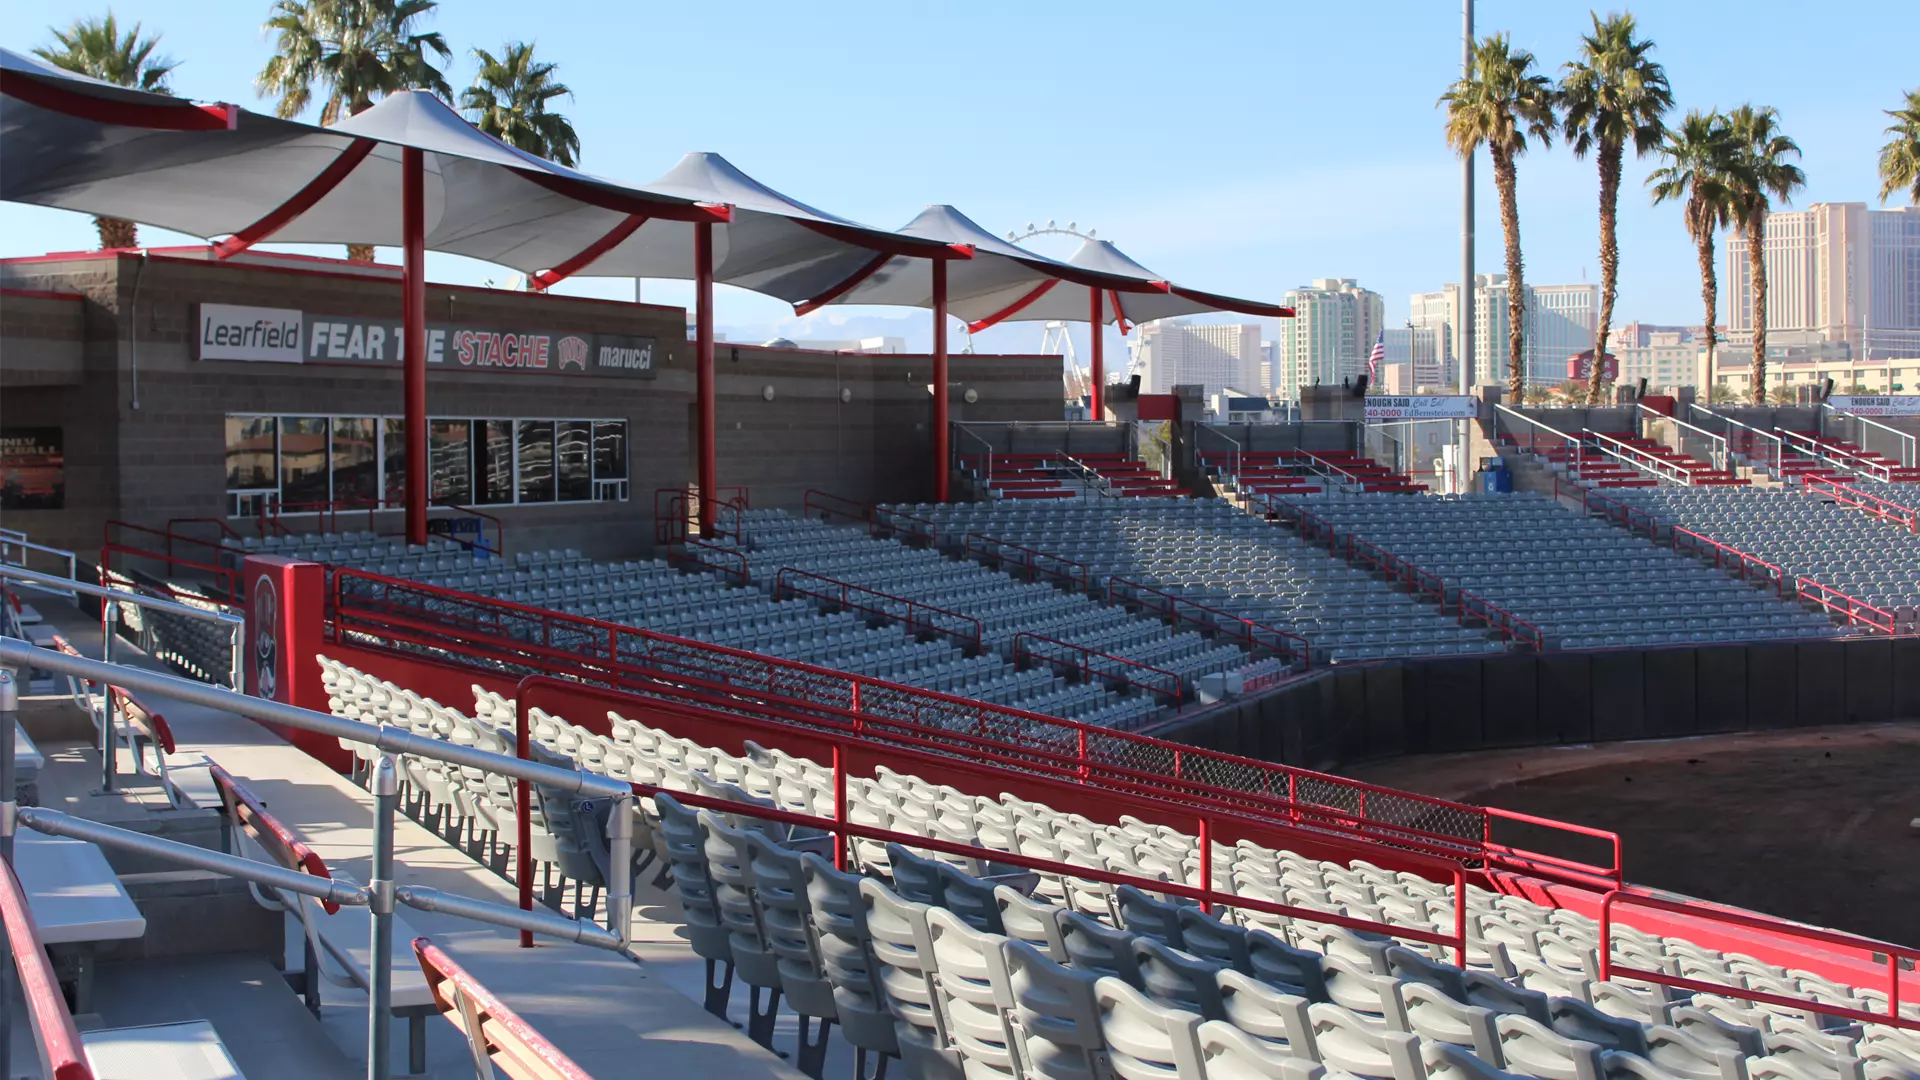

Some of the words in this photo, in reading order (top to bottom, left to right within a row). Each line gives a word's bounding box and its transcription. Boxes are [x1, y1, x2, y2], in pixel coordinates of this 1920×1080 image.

[203, 317, 299, 349] Learfield
[310, 322, 386, 360] FEAR
[394, 327, 446, 363] TE
[599, 345, 652, 369] marucci
[1413, 398, 1428, 408] Call
[1404, 408, 1465, 417] EdBernstein.com
[0, 437, 36, 446] NLV
